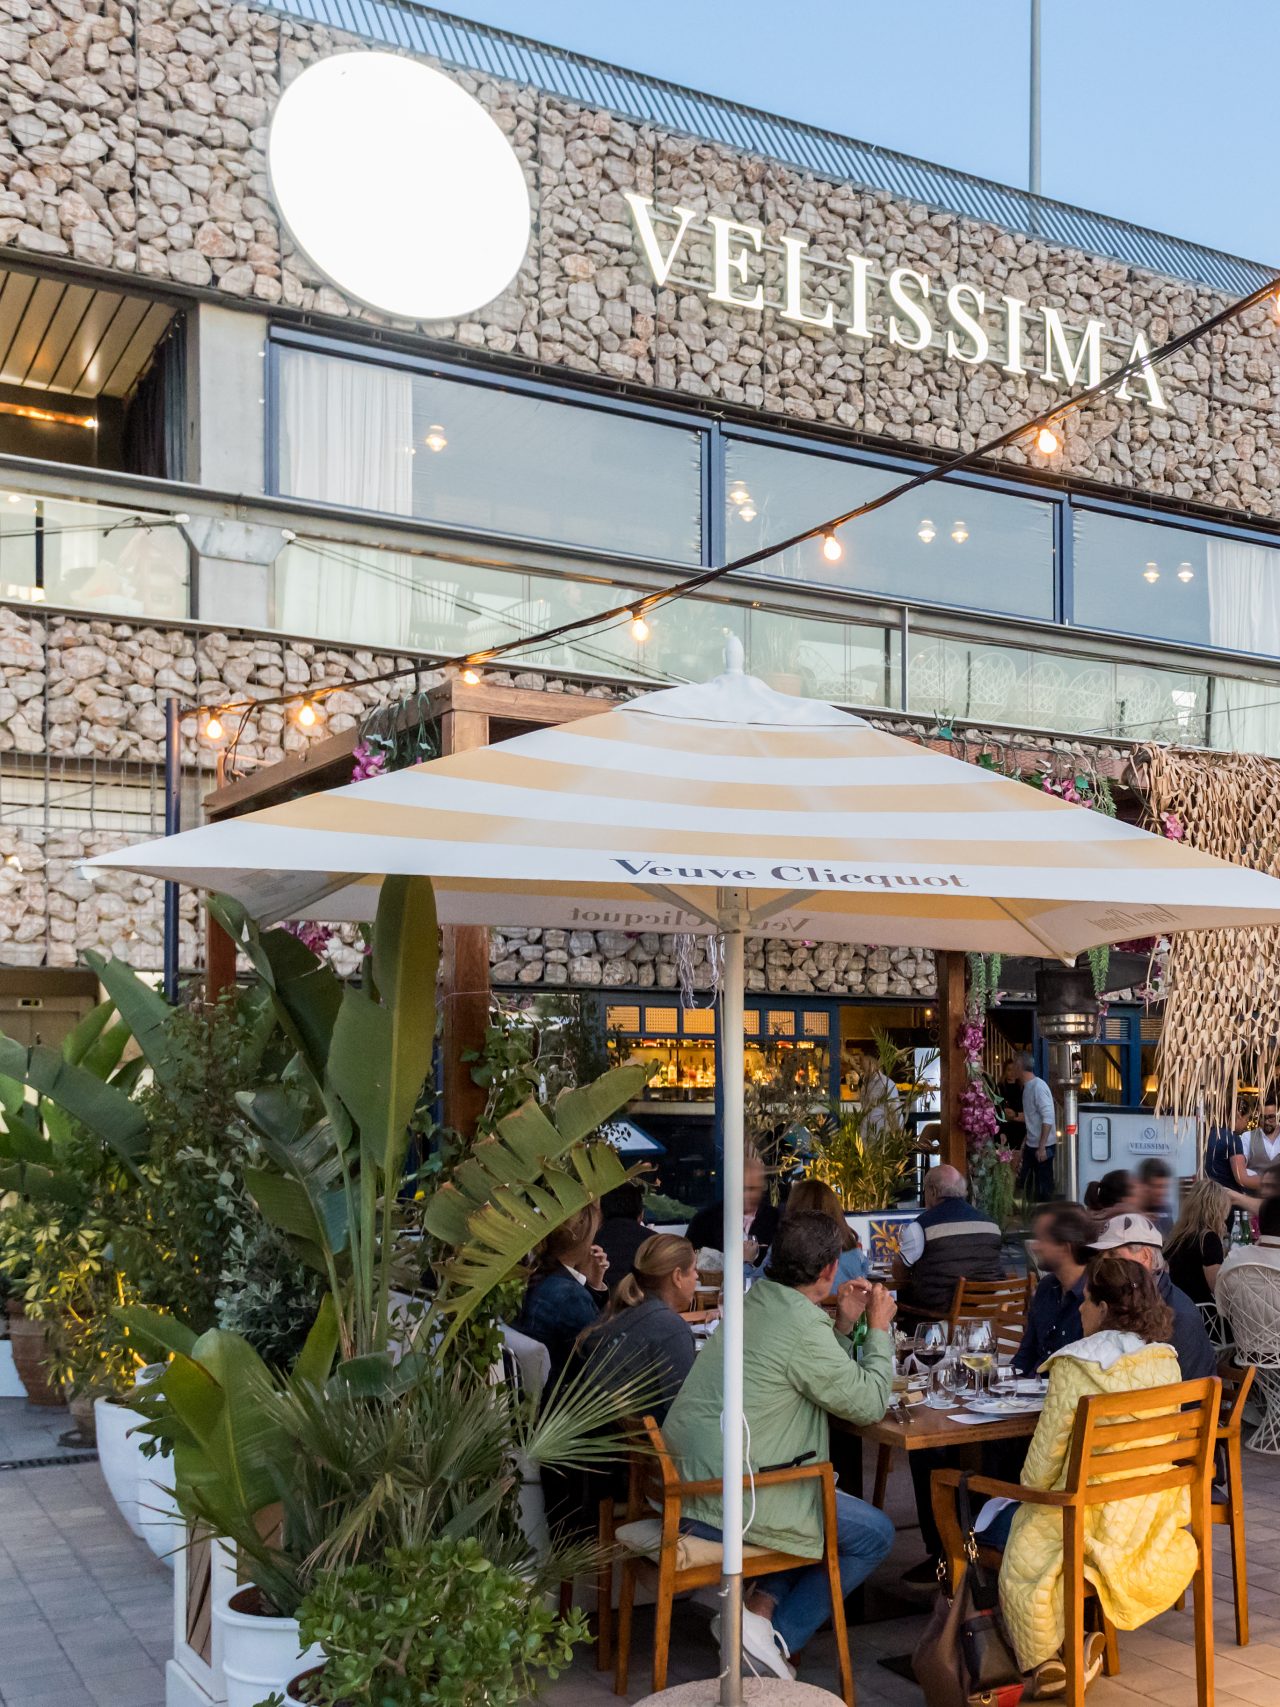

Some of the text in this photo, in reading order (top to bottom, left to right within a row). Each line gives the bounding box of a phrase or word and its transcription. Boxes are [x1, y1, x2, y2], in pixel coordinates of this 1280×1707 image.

[624, 192, 1169, 411] VELISSIMA
[609, 858, 969, 888] Veuve Clicquot
[1129, 1141, 1170, 1151] VELISSIMA
